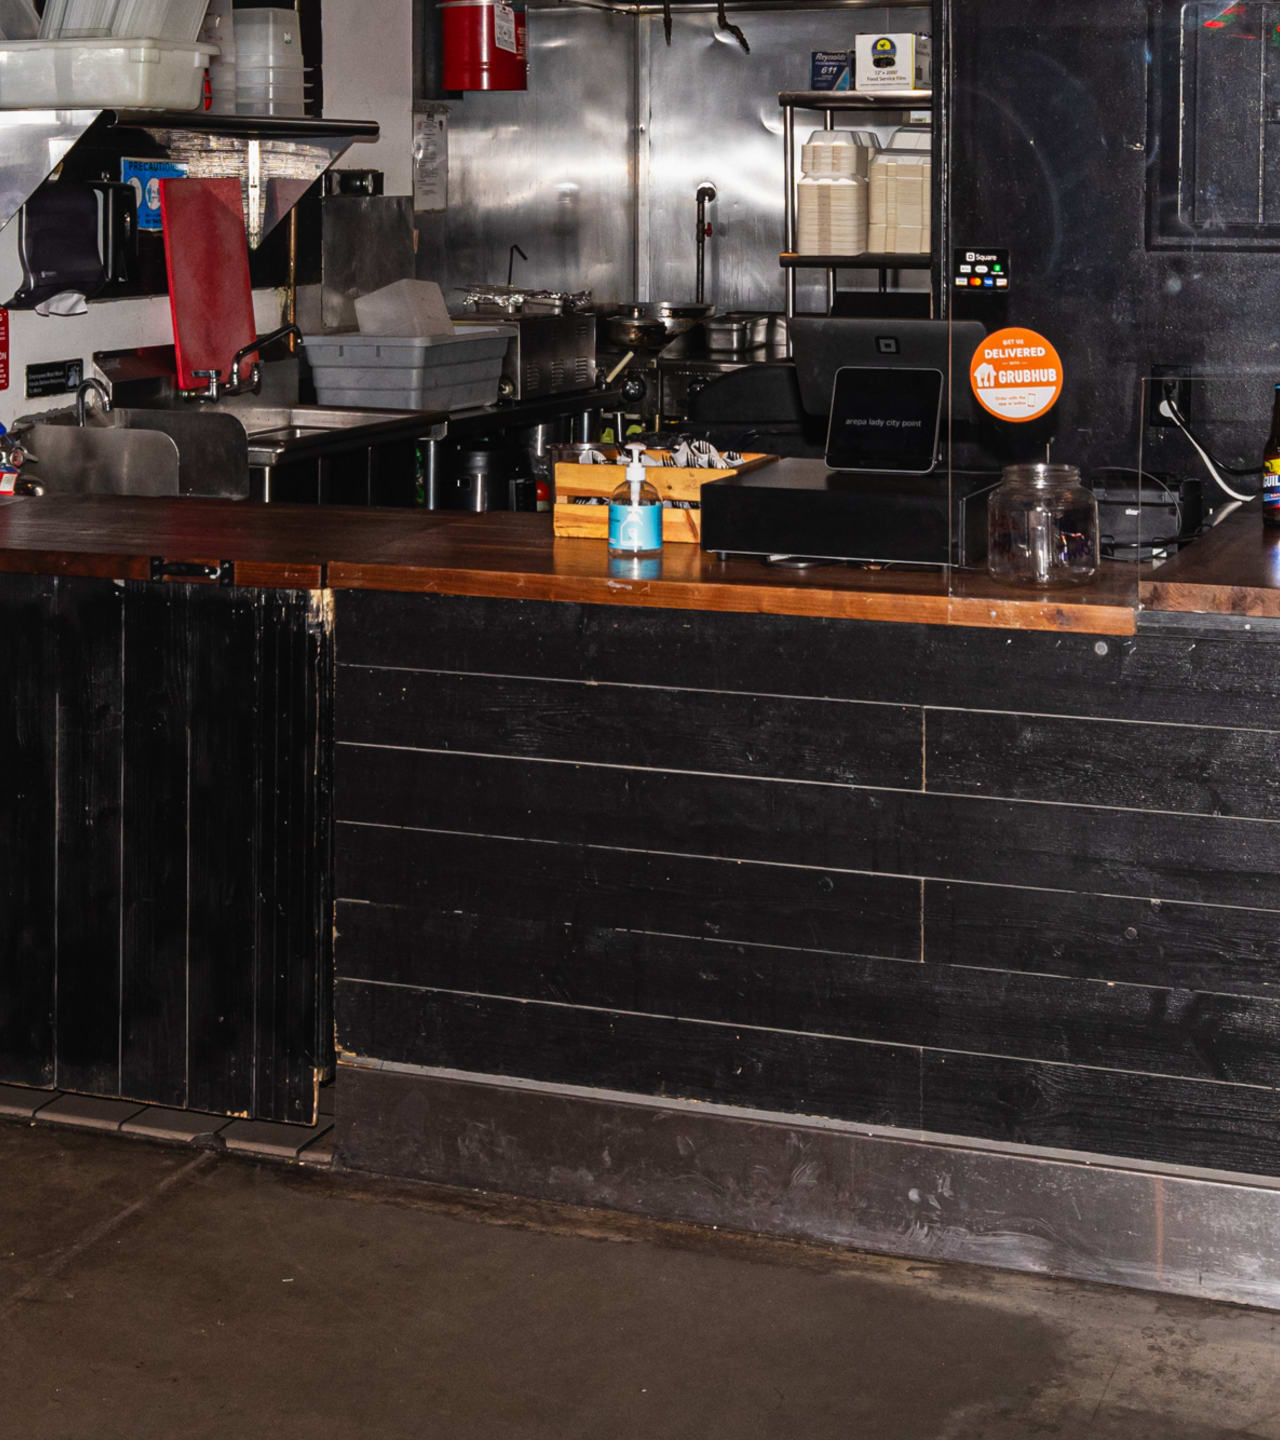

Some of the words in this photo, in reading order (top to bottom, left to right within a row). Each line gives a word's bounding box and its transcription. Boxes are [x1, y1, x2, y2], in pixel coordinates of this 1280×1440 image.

[815, 52, 846, 62] Reynolds
[976, 253, 997, 262] Square
[984, 346, 1046, 359] DELIVERED
[998, 368, 1057, 384] GRUBHUB
[845, 418, 867, 426] arepa
[868, 418, 884, 427] lady
[886, 419, 900, 428] city
[901, 420, 922, 428] point
